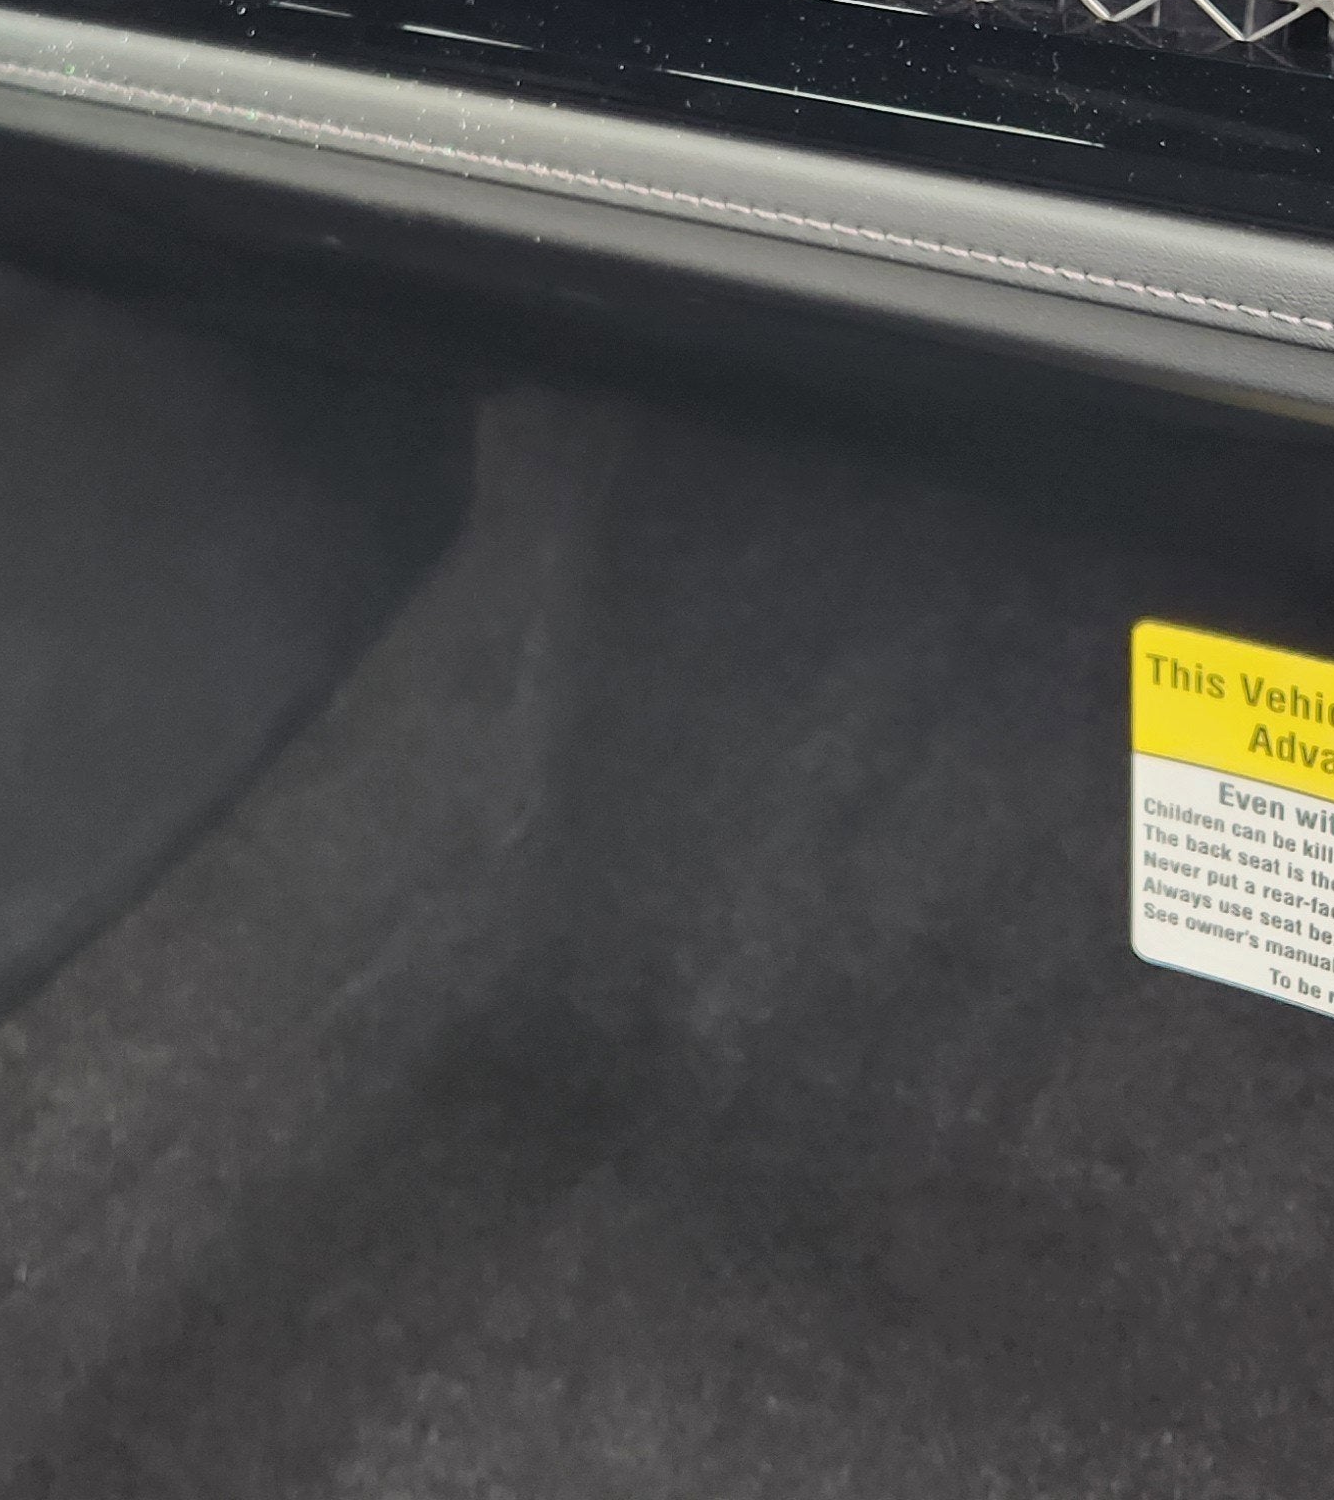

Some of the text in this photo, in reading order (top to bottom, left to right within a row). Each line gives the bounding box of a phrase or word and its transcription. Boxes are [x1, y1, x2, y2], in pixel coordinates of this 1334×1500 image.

[1145, 653, 1226, 699] This
[1218, 781, 1285, 821] Even
[1143, 797, 1225, 833] Children
[1231, 823, 1266, 844] can
[1272, 830, 1296, 853] be
[1143, 823, 1179, 848] The
[1186, 834, 1232, 862] back
[1237, 851, 1280, 876] seat
[1287, 862, 1304, 883] is
[1144, 850, 1201, 879] Never
[1207, 870, 1238, 890] put
[1244, 880, 1256, 895] a
[1143, 876, 1212, 910] Always
[1218, 899, 1253, 921] use
[1259, 911, 1302, 936] seat
[1143, 902, 1179, 926] See
[1185, 916, 1260, 949] owner's
[1269, 967, 1291, 990] To
[1298, 977, 1322, 1000] be
